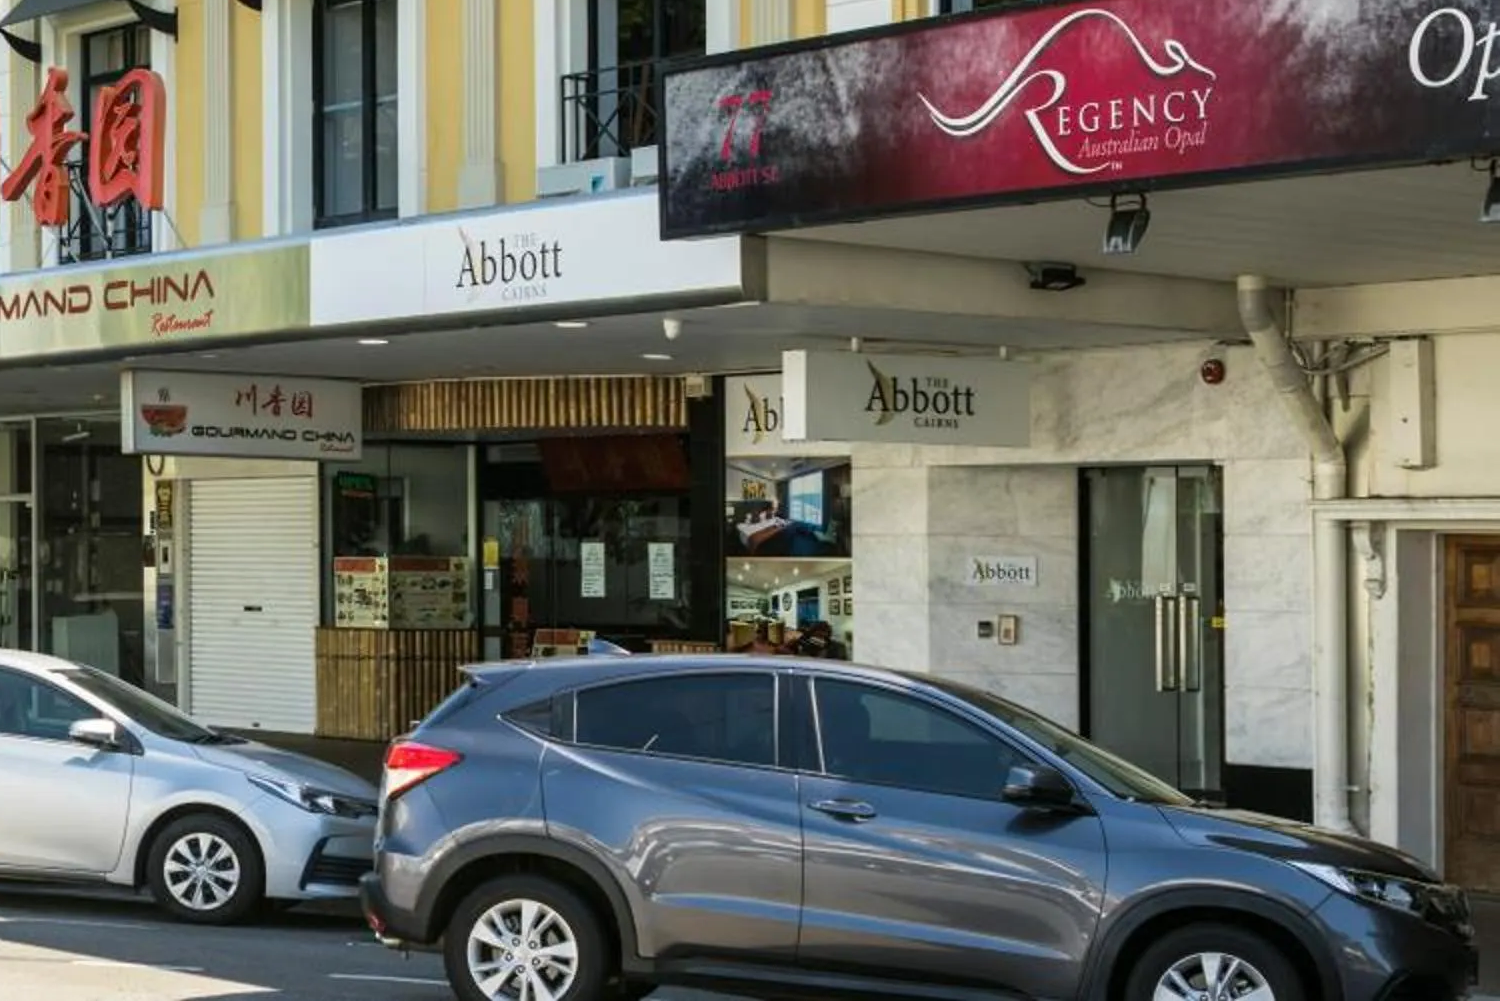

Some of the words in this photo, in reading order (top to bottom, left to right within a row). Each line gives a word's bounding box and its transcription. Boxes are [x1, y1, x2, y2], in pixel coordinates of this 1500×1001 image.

[714, 89, 773, 161] 77
[1077, 128, 1159, 159] Australian
[1164, 121, 1208, 155] Opal
[514, 232, 537, 248] THE
[456, 237, 563, 288] Abbott
[103, 269, 215, 311] CHINA
[501, 282, 548, 301] CAIRNS
[865, 376, 975, 417] Abbott
[926, 377, 949, 389] THE
[743, 397, 784, 433] Ab
[914, 417, 960, 430] CAIRNS
[191, 424, 297, 442] GOURMAND
[302, 429, 355, 444] CHINA
[973, 560, 1030, 581] Abbott
